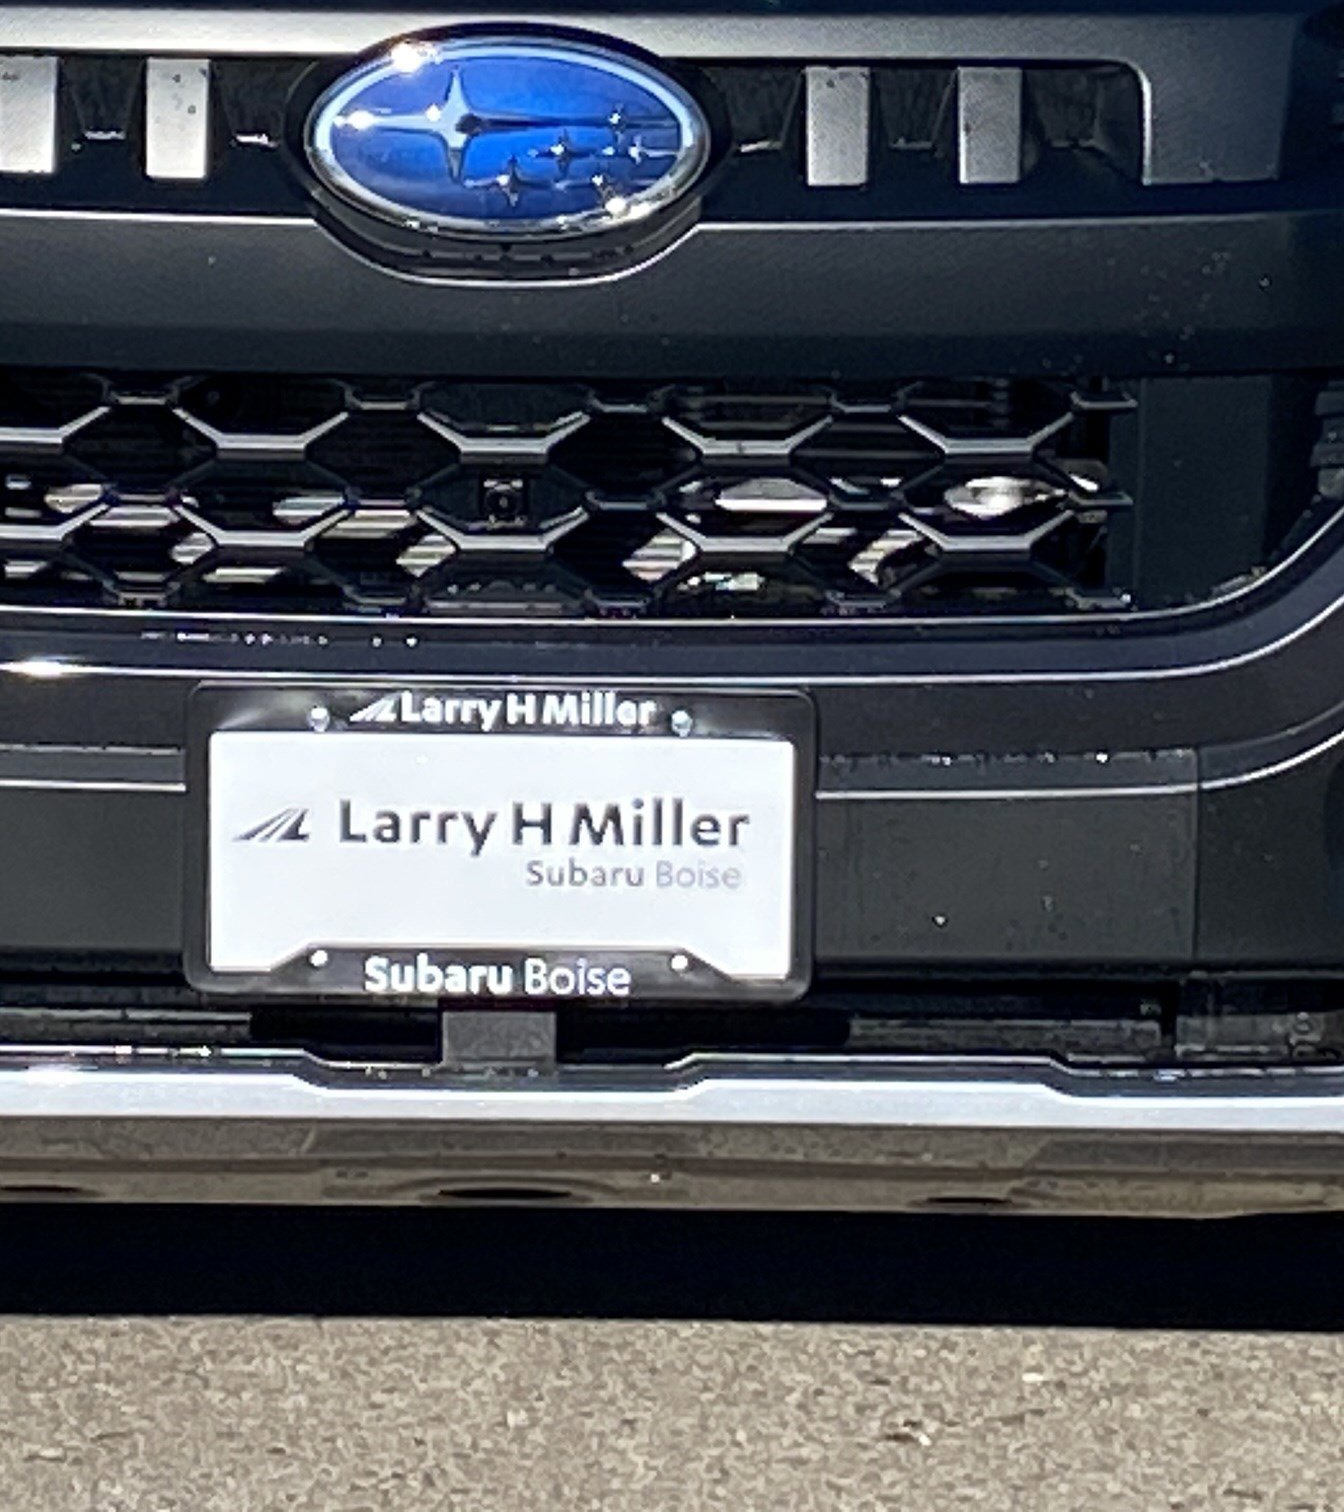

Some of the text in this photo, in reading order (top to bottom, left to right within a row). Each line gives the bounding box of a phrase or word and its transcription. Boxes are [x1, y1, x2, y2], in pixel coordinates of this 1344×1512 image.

[400, 691, 657, 731] Larry H Miller
[338, 796, 751, 857] Larry H Miller
[525, 857, 744, 889] Subaru Boise
[364, 953, 632, 996] Subaru Boise
